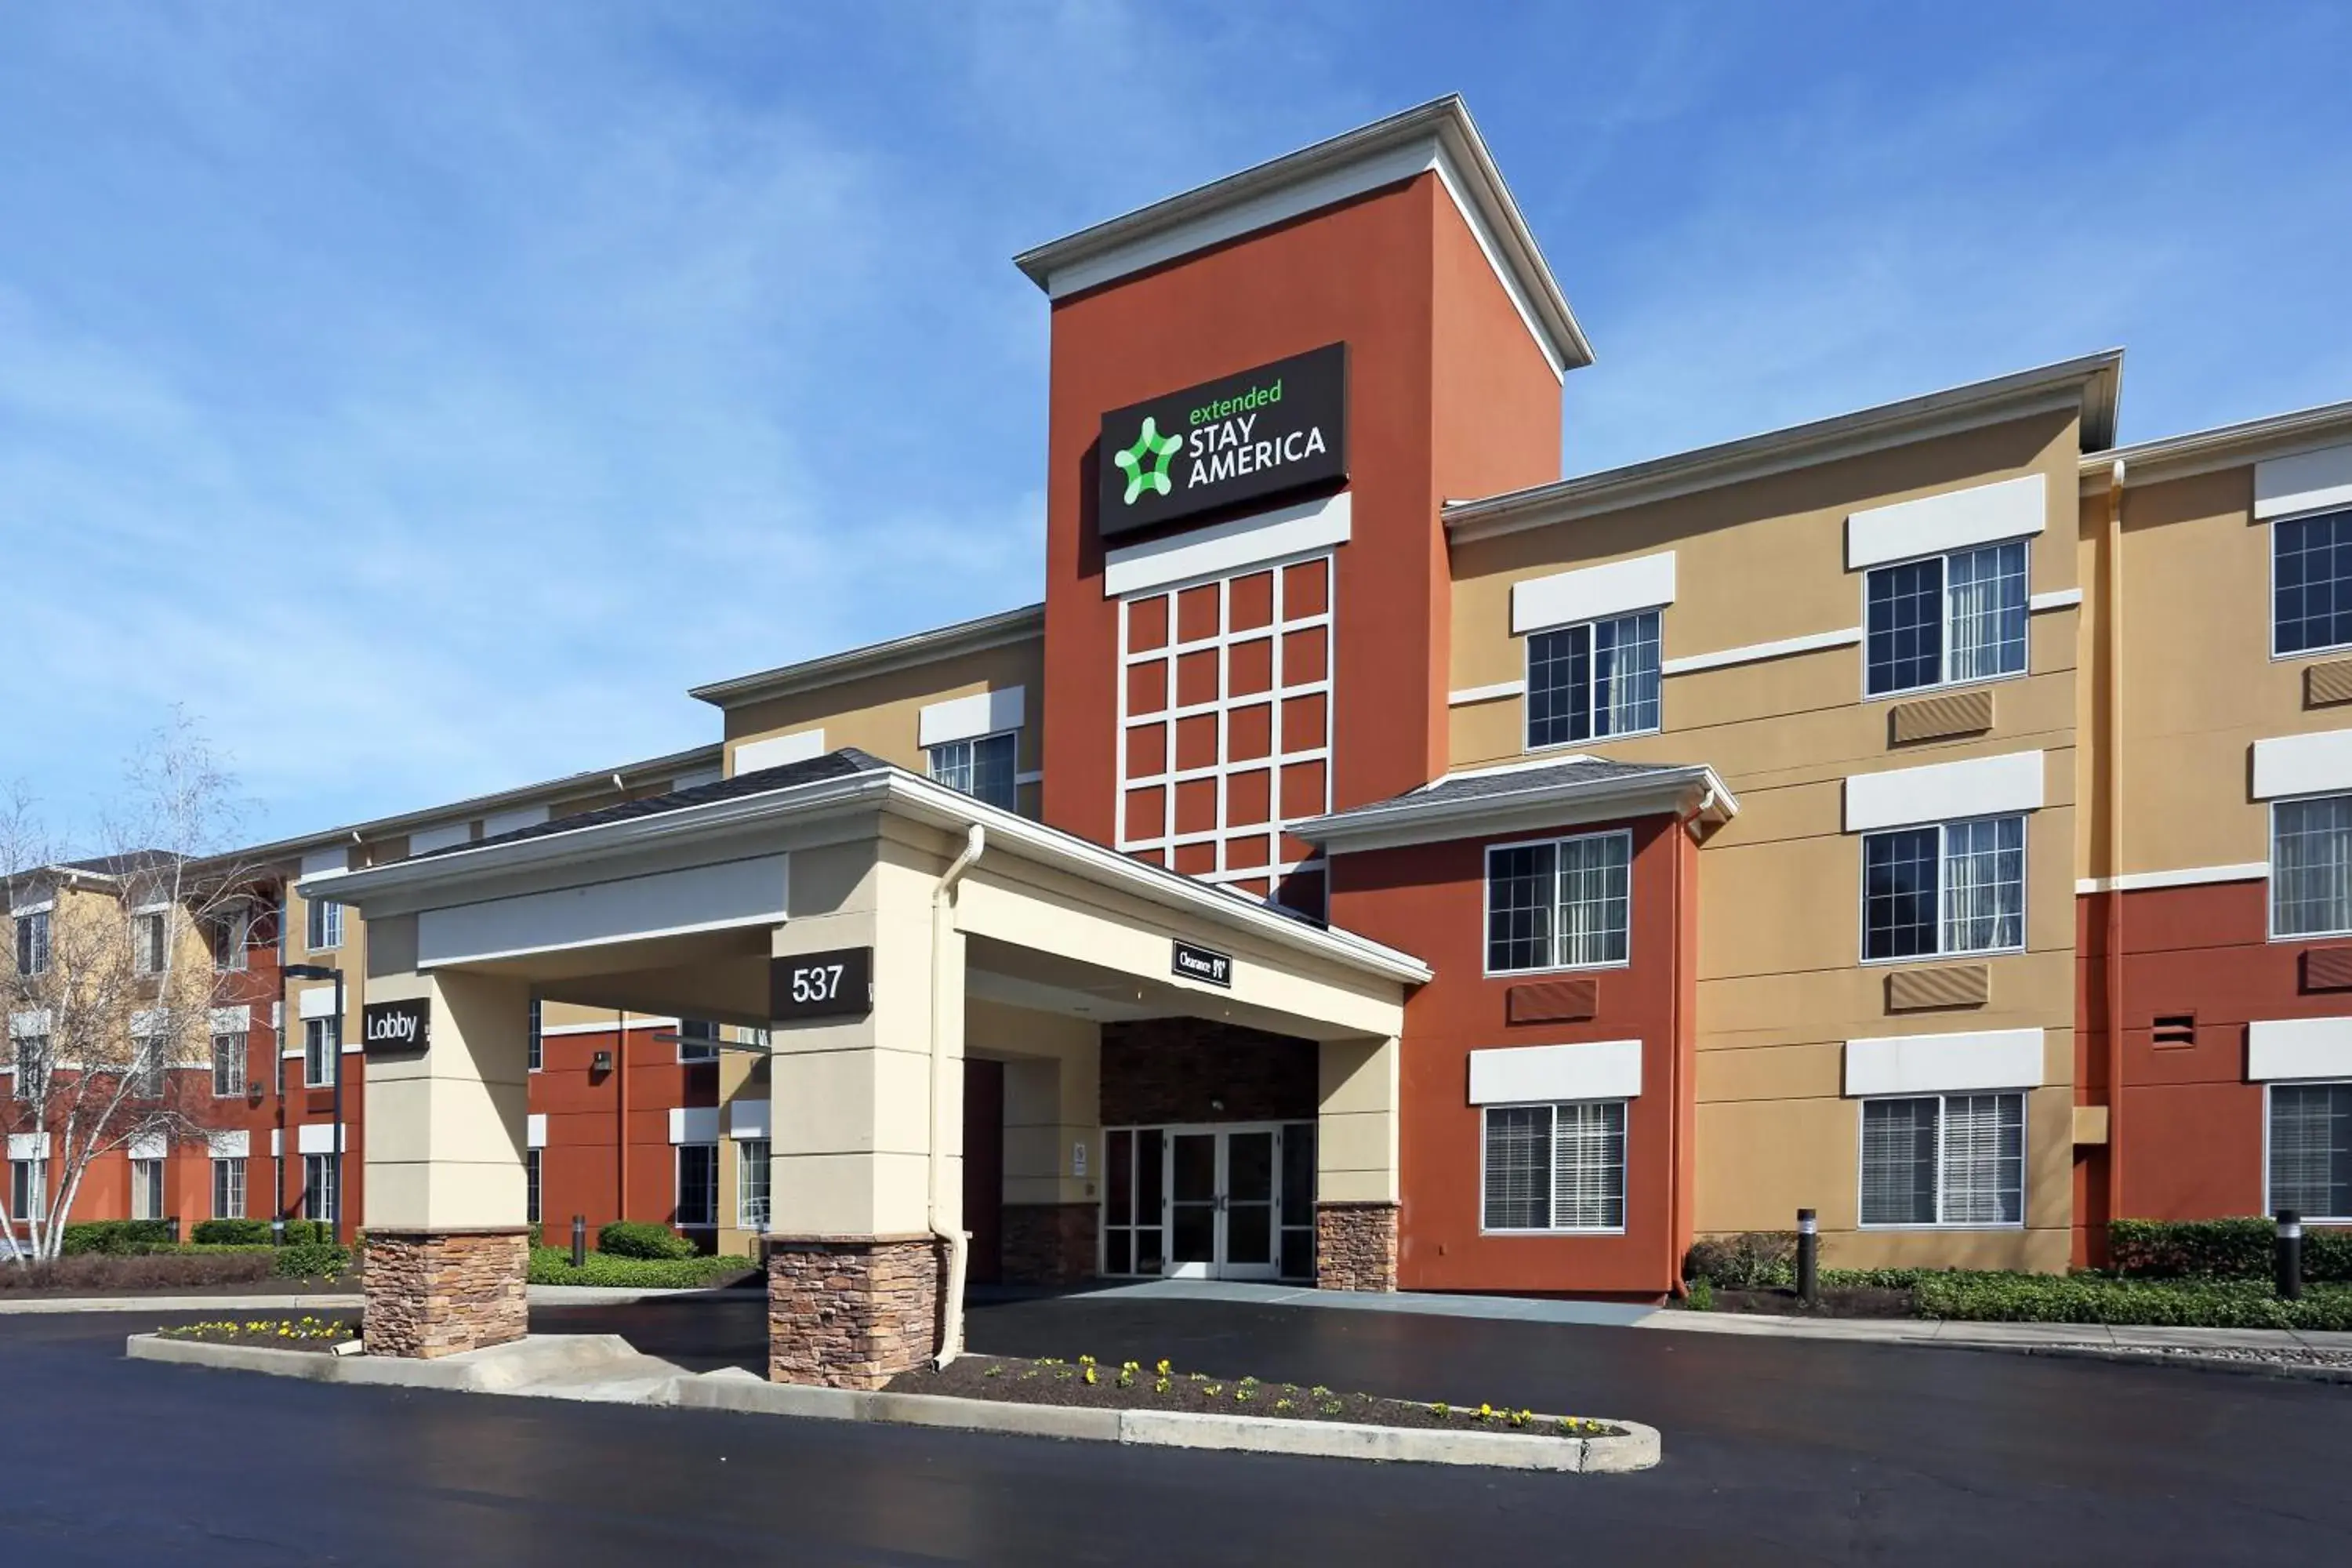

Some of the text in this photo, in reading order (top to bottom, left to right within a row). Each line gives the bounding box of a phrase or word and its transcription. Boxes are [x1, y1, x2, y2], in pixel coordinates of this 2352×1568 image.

[1189, 379, 1282, 425] extended
[1188, 426, 1327, 488] AMERICA
[1189, 413, 1257, 459] STAY
[793, 964, 844, 1002] 537
[368, 1011, 417, 1042] Lobby
